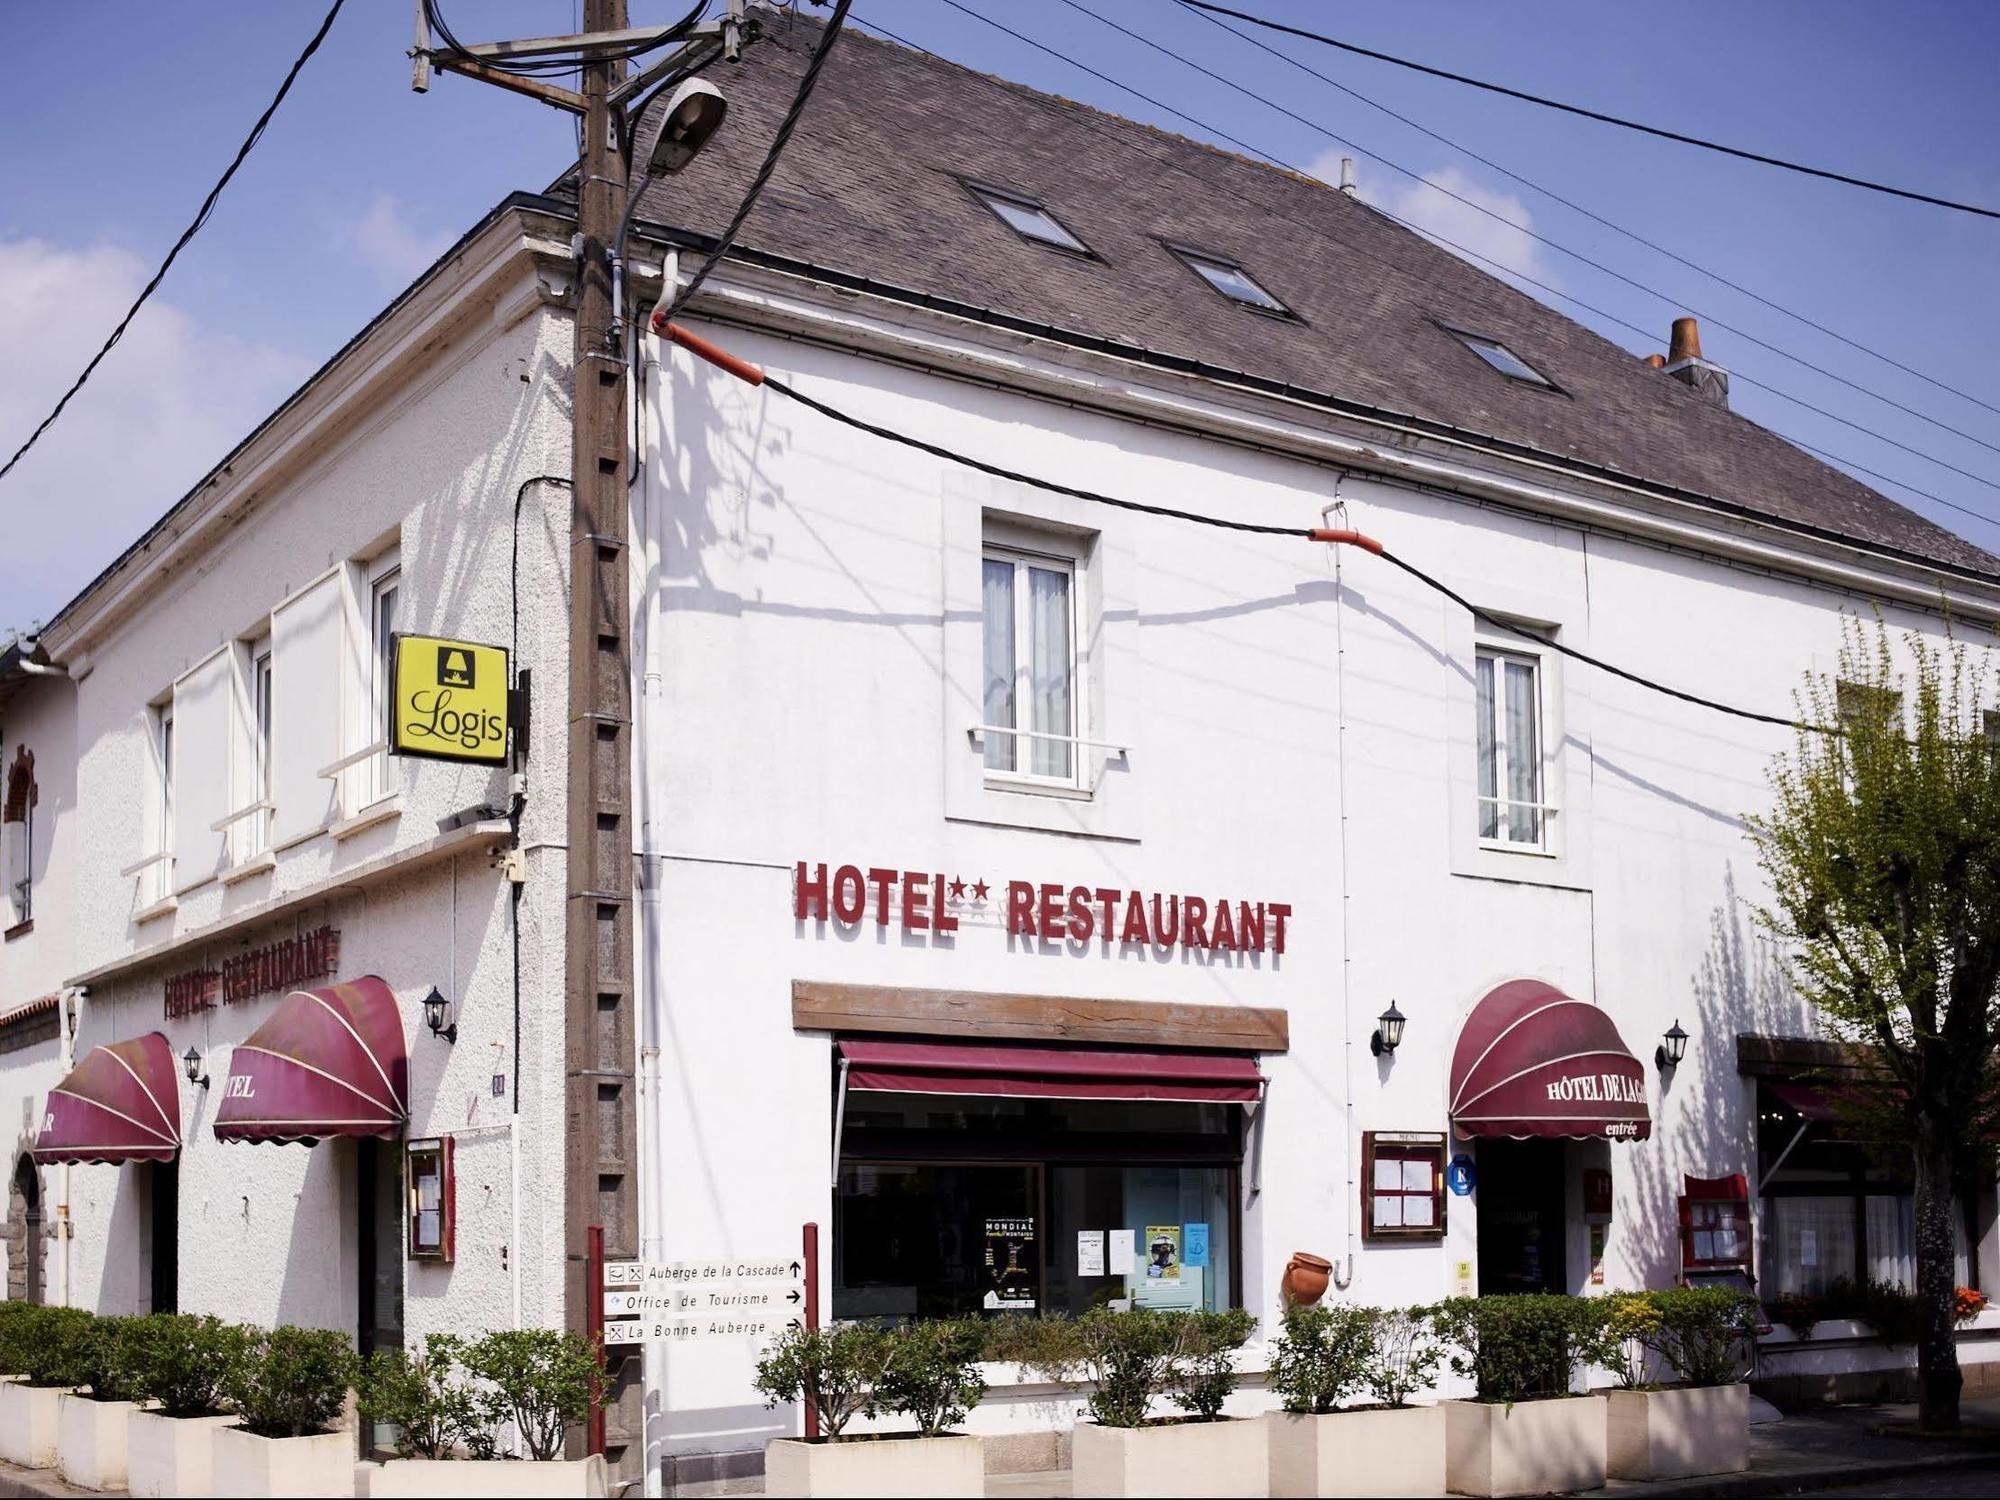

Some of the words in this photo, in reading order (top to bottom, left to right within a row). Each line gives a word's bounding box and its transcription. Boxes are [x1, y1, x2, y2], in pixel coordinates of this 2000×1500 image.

[407, 689, 503, 749] Logis
[795, 861, 959, 931] HOTEL
[1007, 879, 1292, 954] RESTAURANT
[1546, 1075, 1603, 1101] HÔTEL
[1601, 1074, 1622, 1102] DE
[1619, 1074, 1637, 1103] LA
[1605, 1121, 1638, 1136] entrée
[985, 1223, 1034, 1231] MONDIAL
[649, 1266, 698, 1281] Auberge
[703, 1265, 717, 1277] de
[721, 1265, 732, 1277] la
[737, 1264, 785, 1277] Cascade
[626, 1296, 670, 1309] Office
[681, 1295, 697, 1307] de
[709, 1292, 769, 1306] Tourisme
[628, 1326, 643, 1338] La
[654, 1325, 697, 1337] Bonne
[708, 1322, 765, 1336] Auberge
